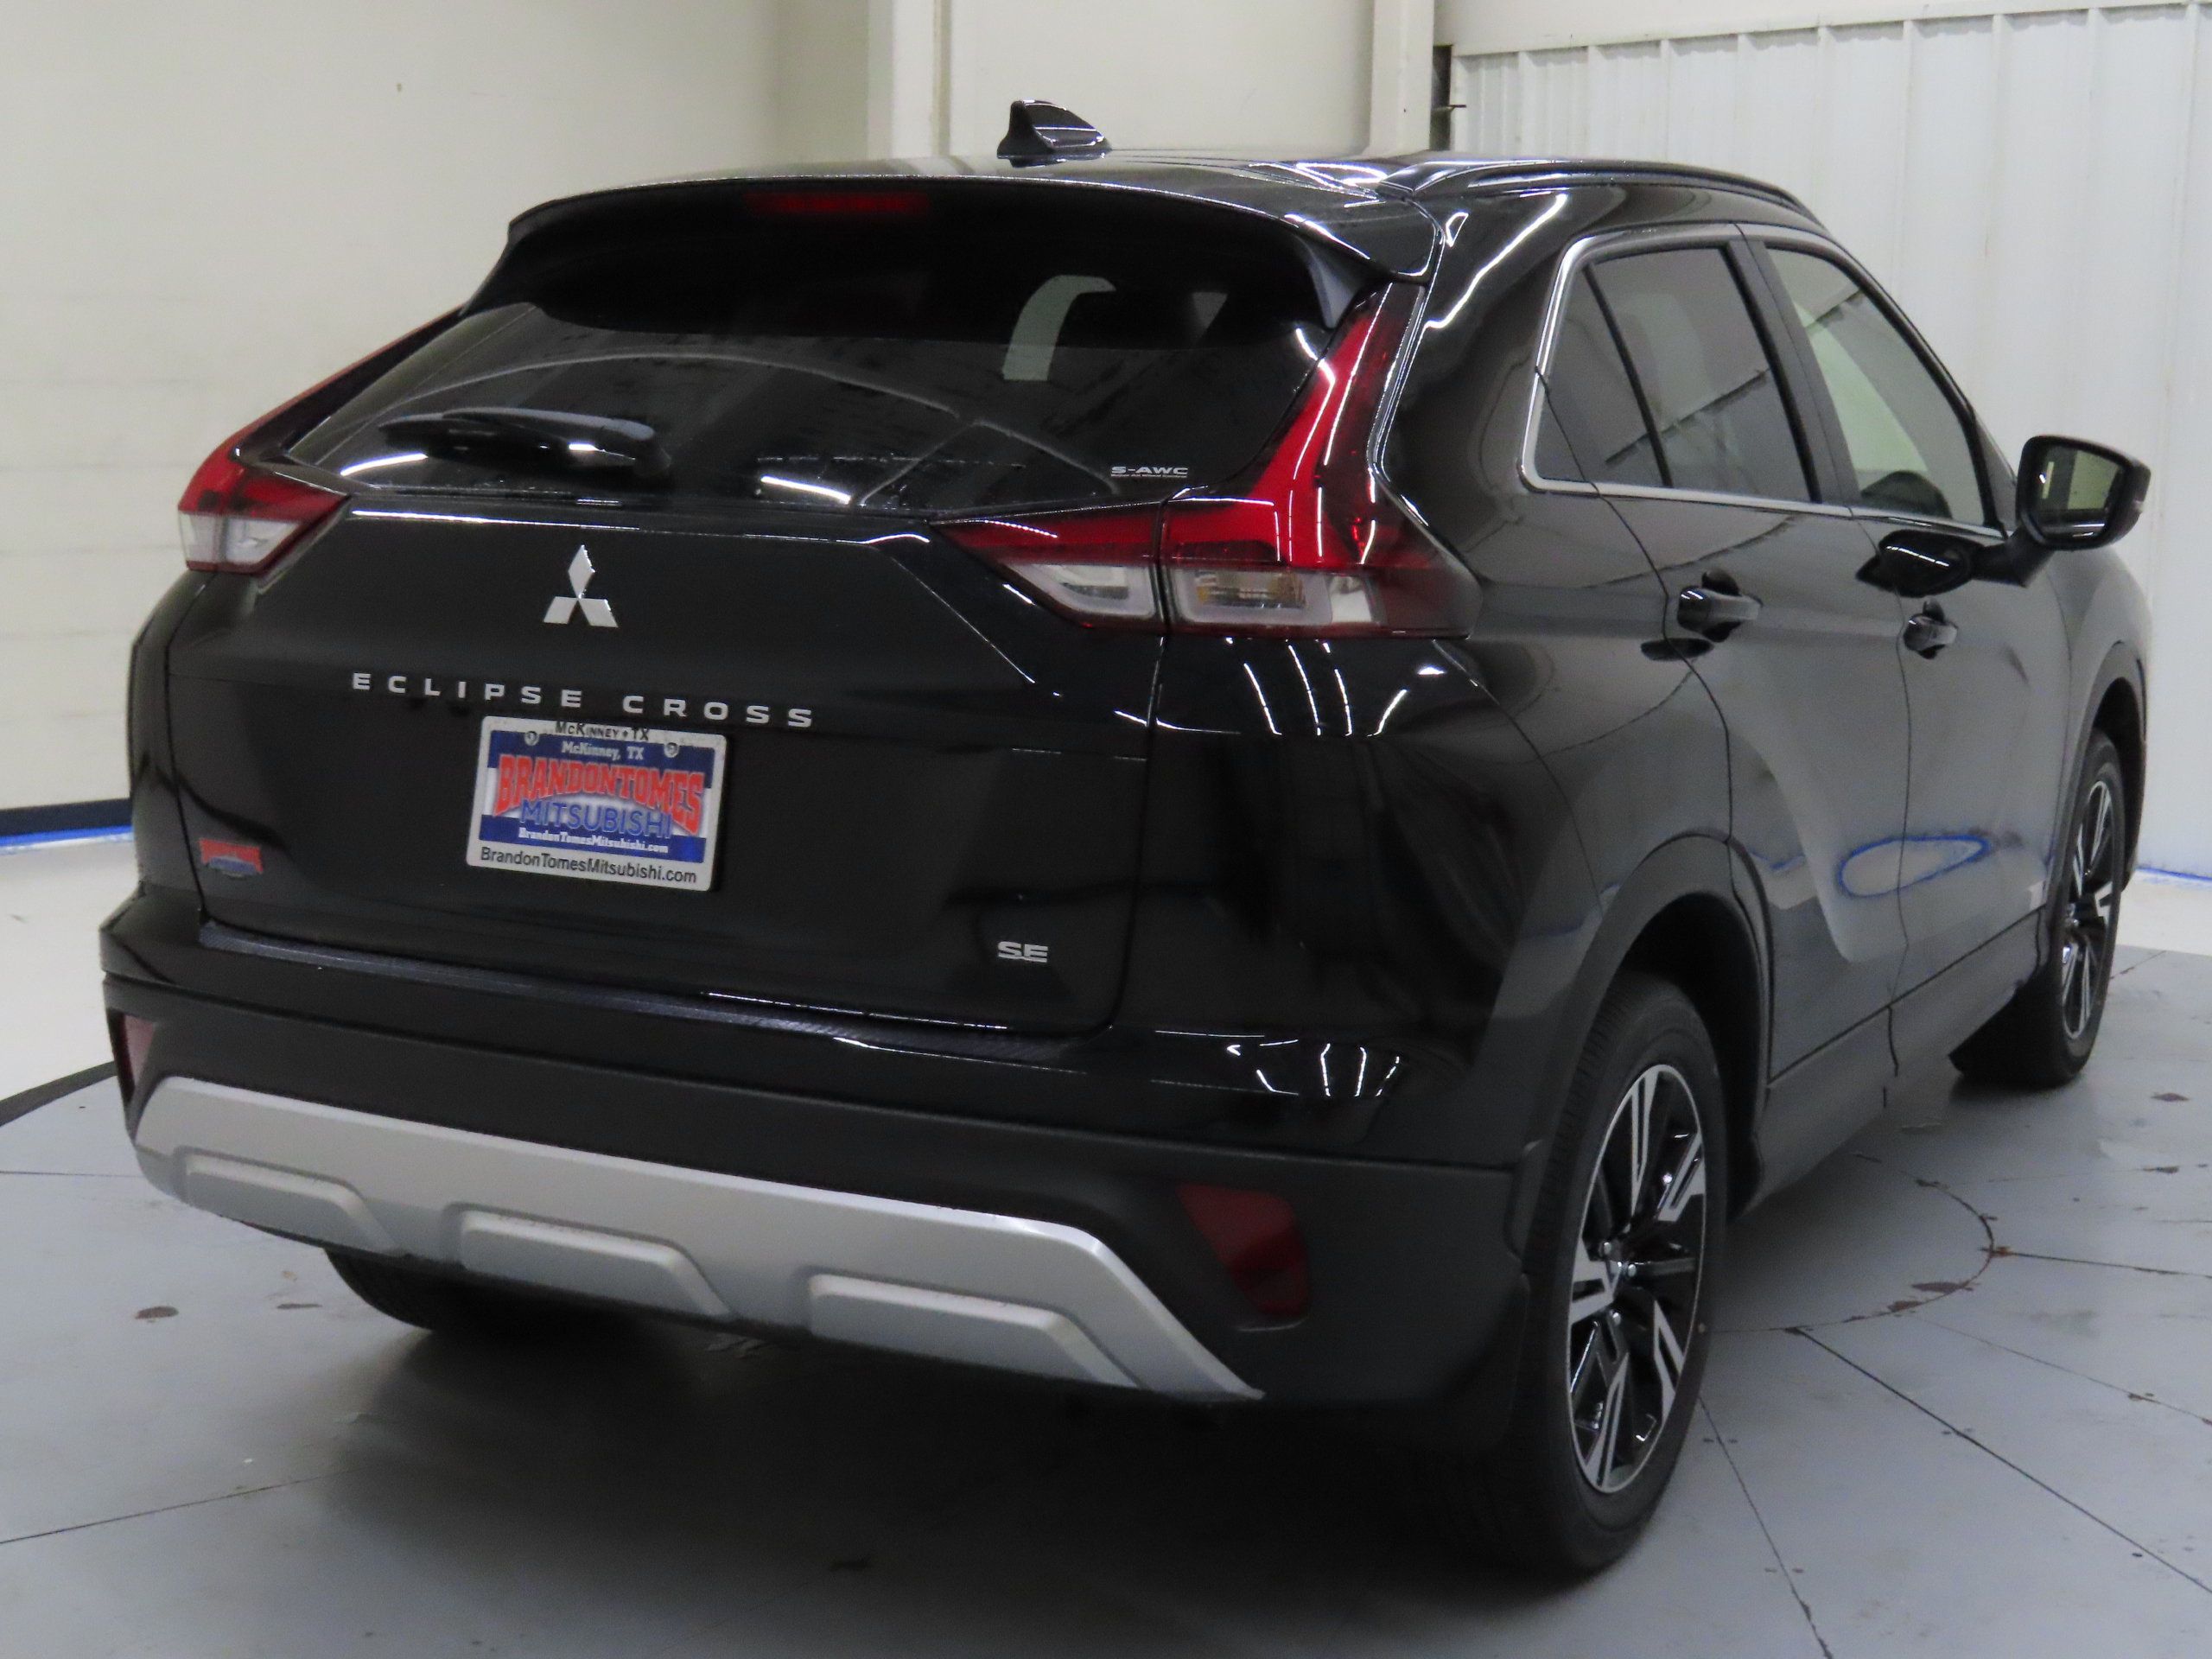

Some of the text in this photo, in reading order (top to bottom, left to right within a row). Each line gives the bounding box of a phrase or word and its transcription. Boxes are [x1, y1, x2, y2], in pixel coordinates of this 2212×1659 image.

[1111, 466, 1188, 475] S-AWC
[352, 672, 813, 728] ECLIPSE CROSS
[626, 746, 645, 760] TX
[519, 798, 674, 839] MITSUBISHI
[480, 847, 697, 883] BrandonTomesMitsubishi.com
[997, 940, 1049, 963] SE
